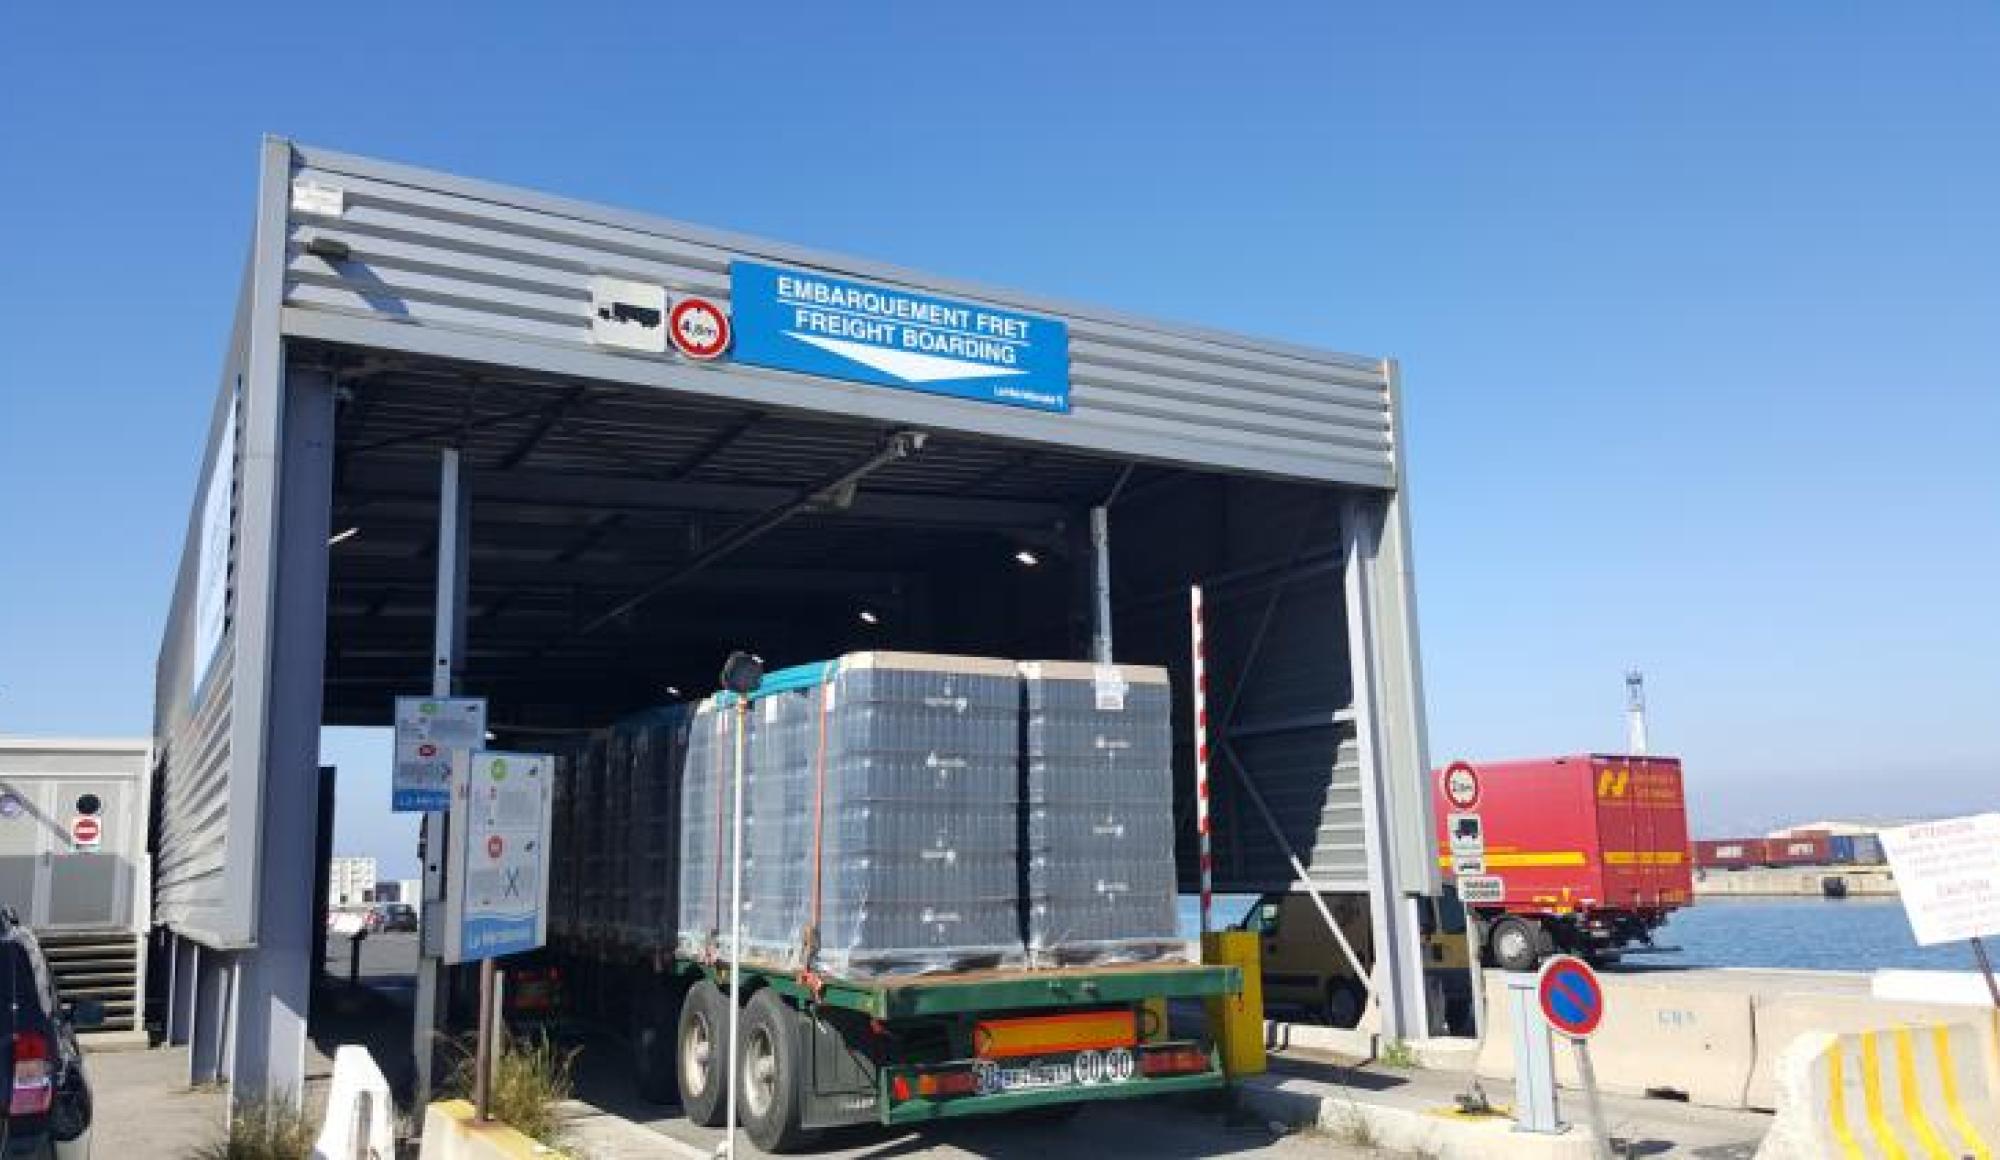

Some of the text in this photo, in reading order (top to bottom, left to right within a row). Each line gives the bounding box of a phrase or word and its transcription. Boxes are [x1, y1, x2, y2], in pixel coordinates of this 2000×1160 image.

[778, 276, 1029, 339] EMBARQUEMENT FRET
[796, 310, 1016, 364] FREIGHT BOARDING
